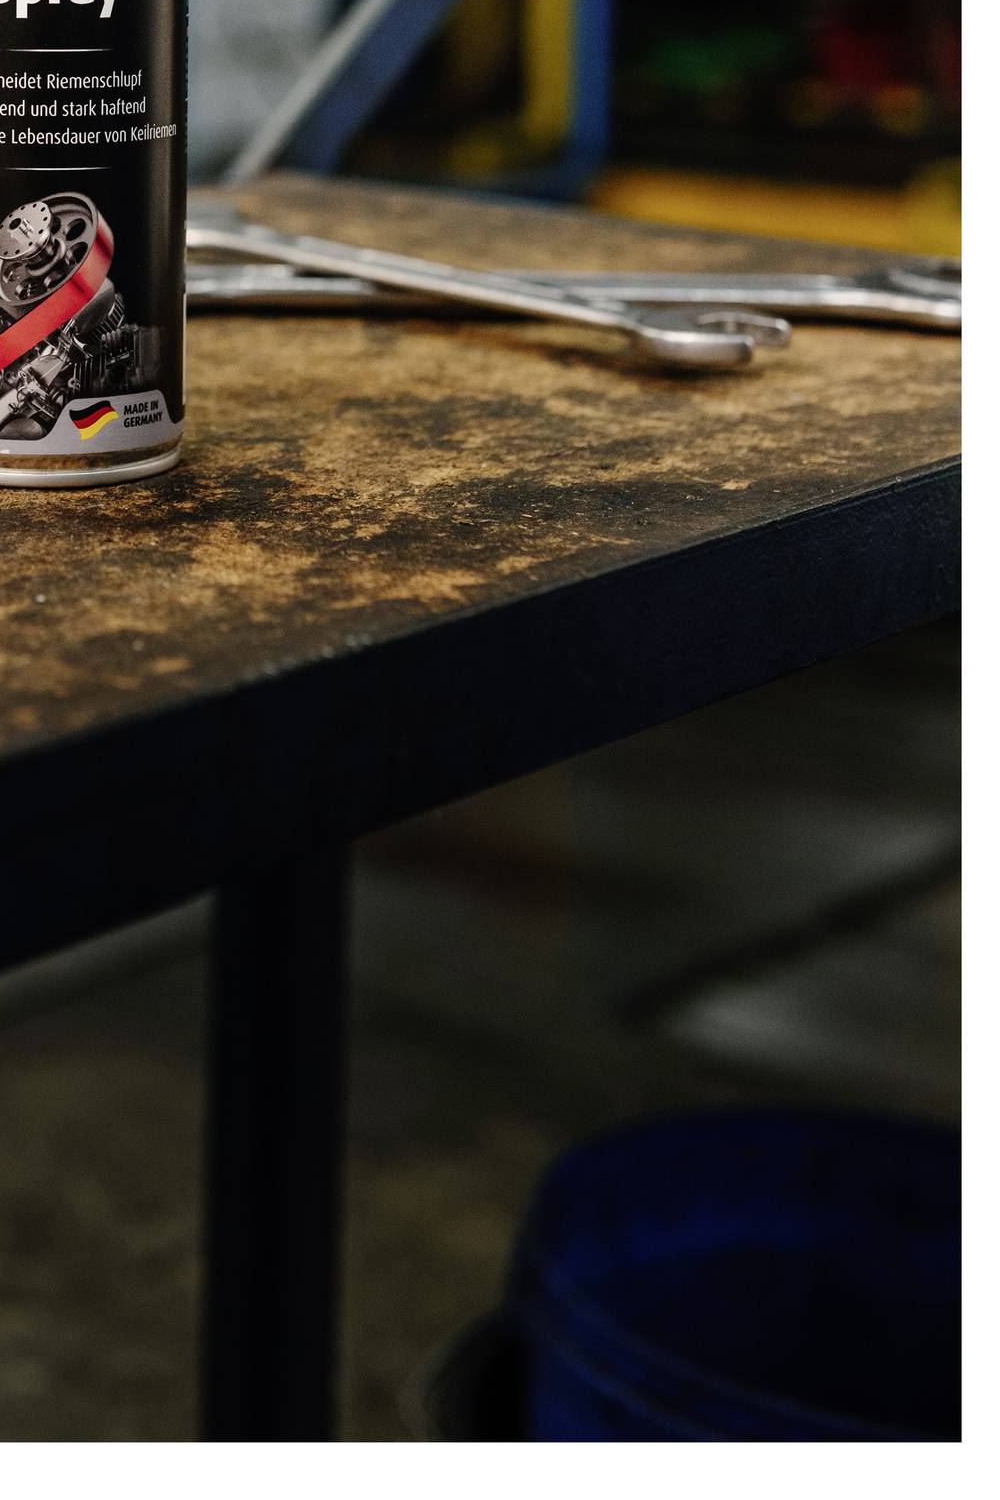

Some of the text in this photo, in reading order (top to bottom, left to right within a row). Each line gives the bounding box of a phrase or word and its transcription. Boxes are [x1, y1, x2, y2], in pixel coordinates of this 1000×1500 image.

[47, 70, 142, 90] Riemenschlupf
[31, 100, 58, 117] und
[62, 99, 97, 117] stark
[101, 97, 146, 115] haftend
[11, 127, 100, 146] Lebensdauer
[105, 130, 127, 143] von
[131, 123, 177, 142] Keilriemen
[124, 400, 159, 415] MADE IN
[124, 411, 163, 428] GERMANY
